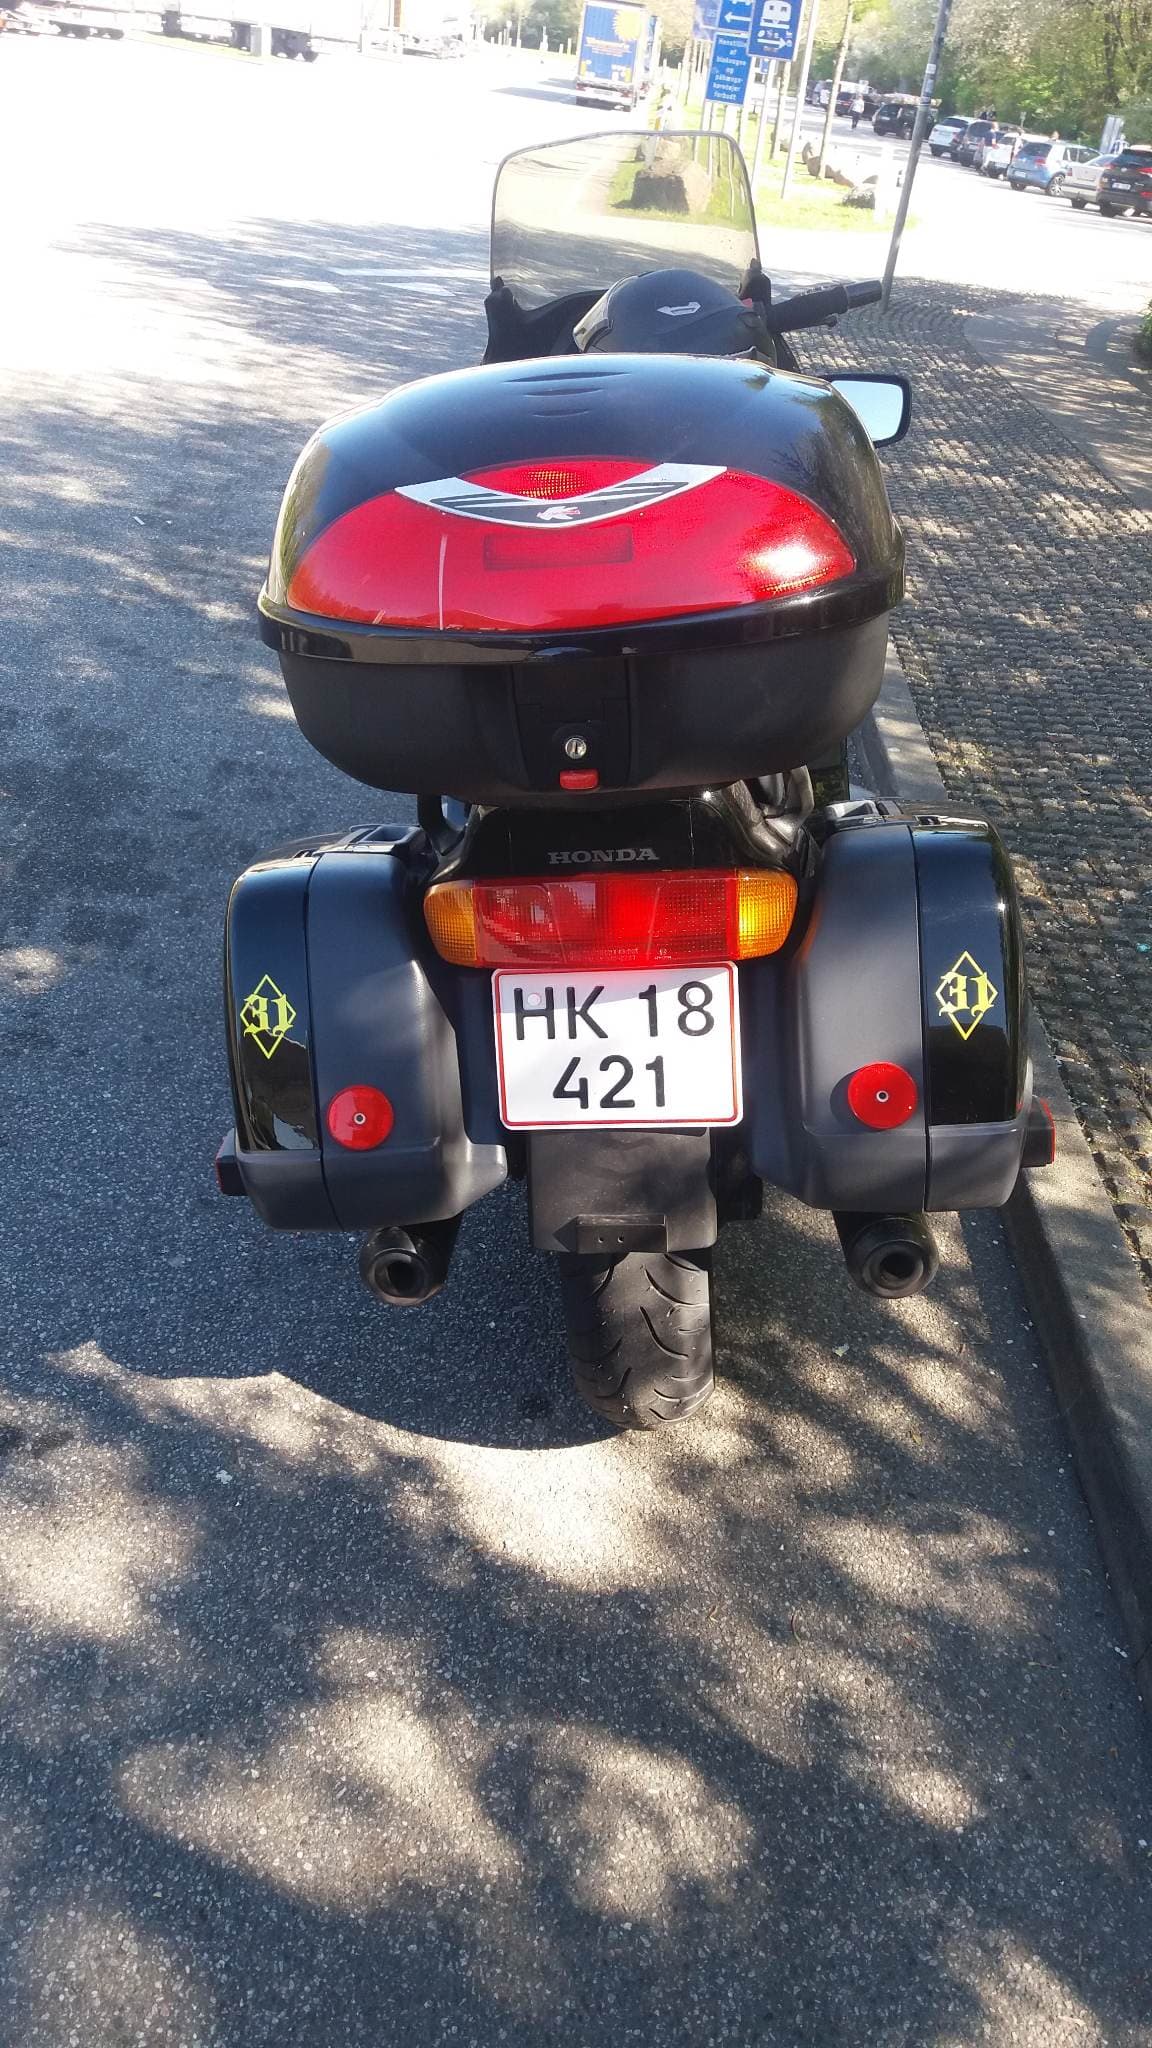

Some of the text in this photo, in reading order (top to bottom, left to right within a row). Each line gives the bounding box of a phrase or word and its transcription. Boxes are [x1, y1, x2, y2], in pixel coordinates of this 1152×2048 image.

[547, 848, 660, 864] HONDA
[513, 980, 715, 1040] HK 18
[552, 1054, 666, 1110] 421
